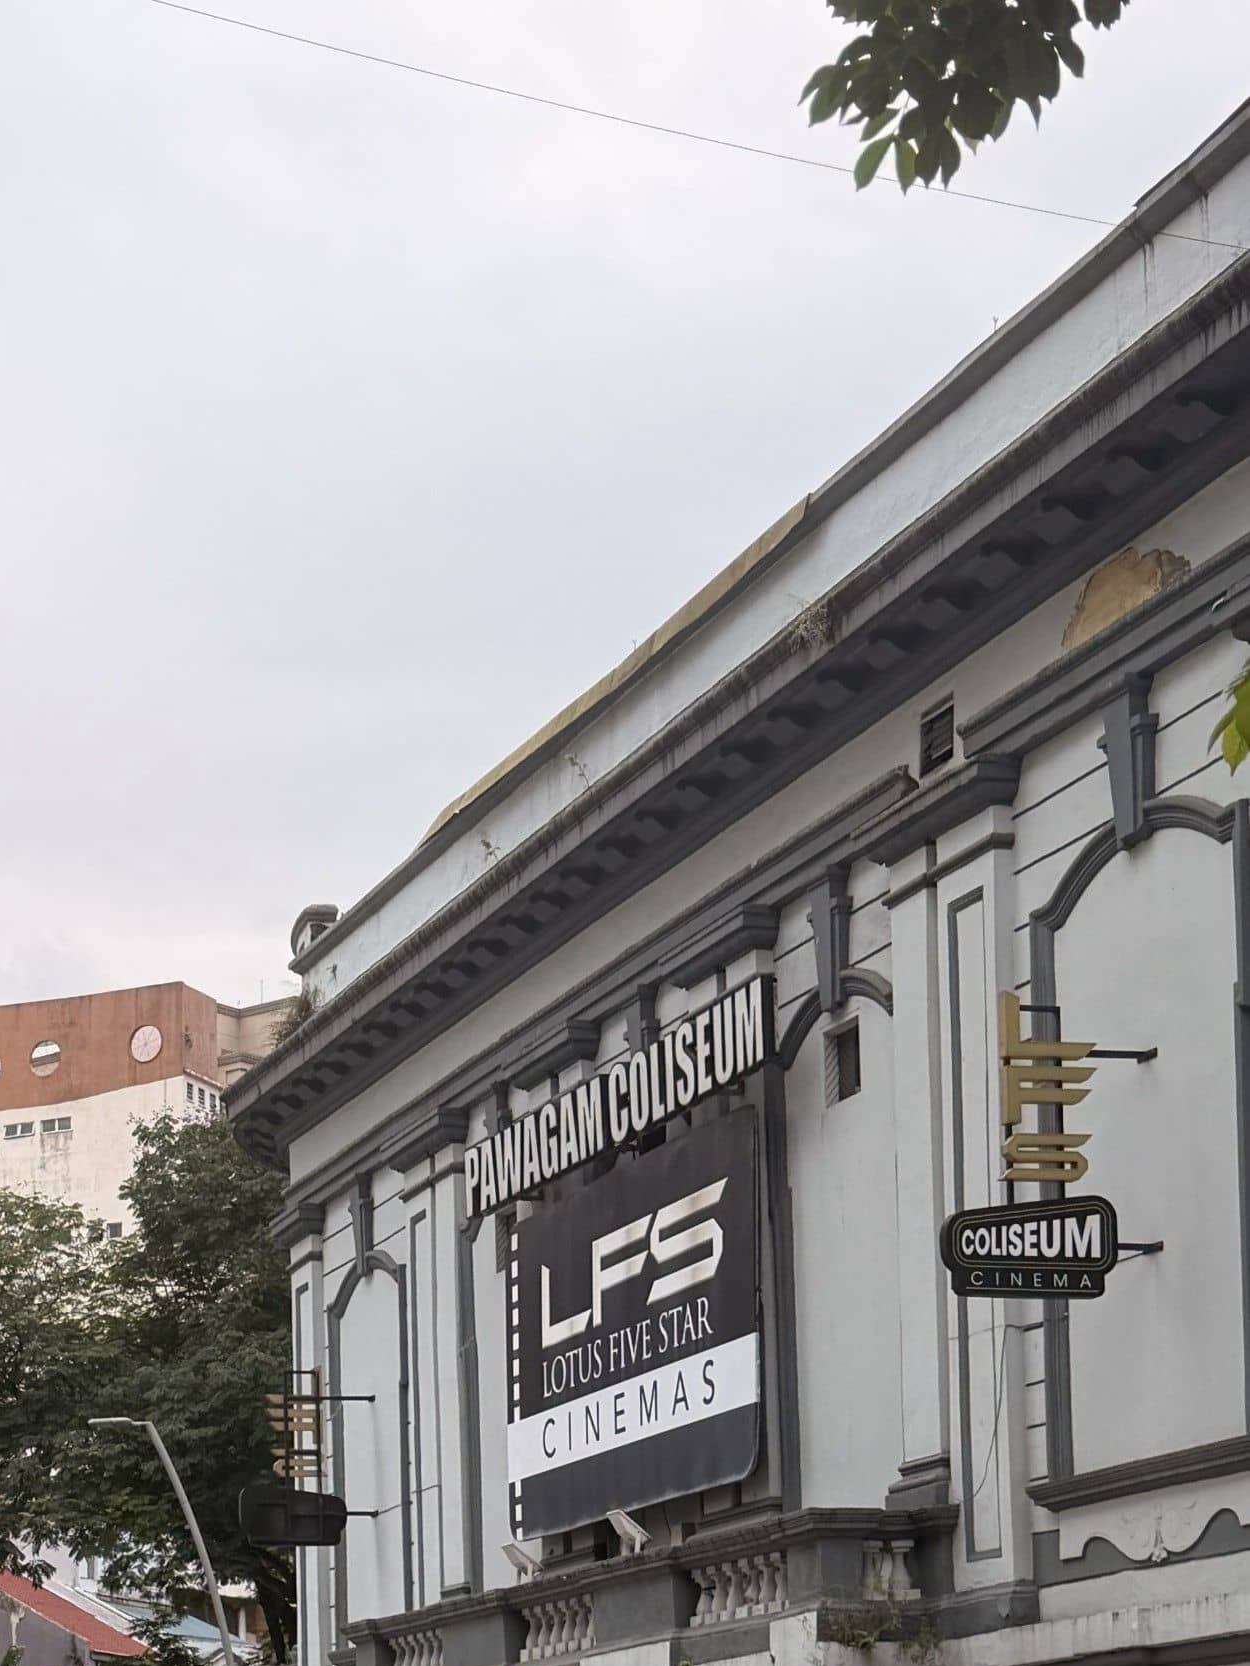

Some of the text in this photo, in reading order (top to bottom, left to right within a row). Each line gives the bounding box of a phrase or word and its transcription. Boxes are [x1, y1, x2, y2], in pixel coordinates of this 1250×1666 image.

[464, 976, 765, 1218] PAWAGAM COLISEUM
[998, 990, 1098, 1183] LFS
[541, 1176, 729, 1350] LFS
[961, 1213, 1101, 1259] COLISEUM
[970, 1270, 1092, 1289] CINEMA
[542, 1296, 714, 1400] LOTUS FIVE STAR
[542, 1359, 716, 1458] CINEMAS
